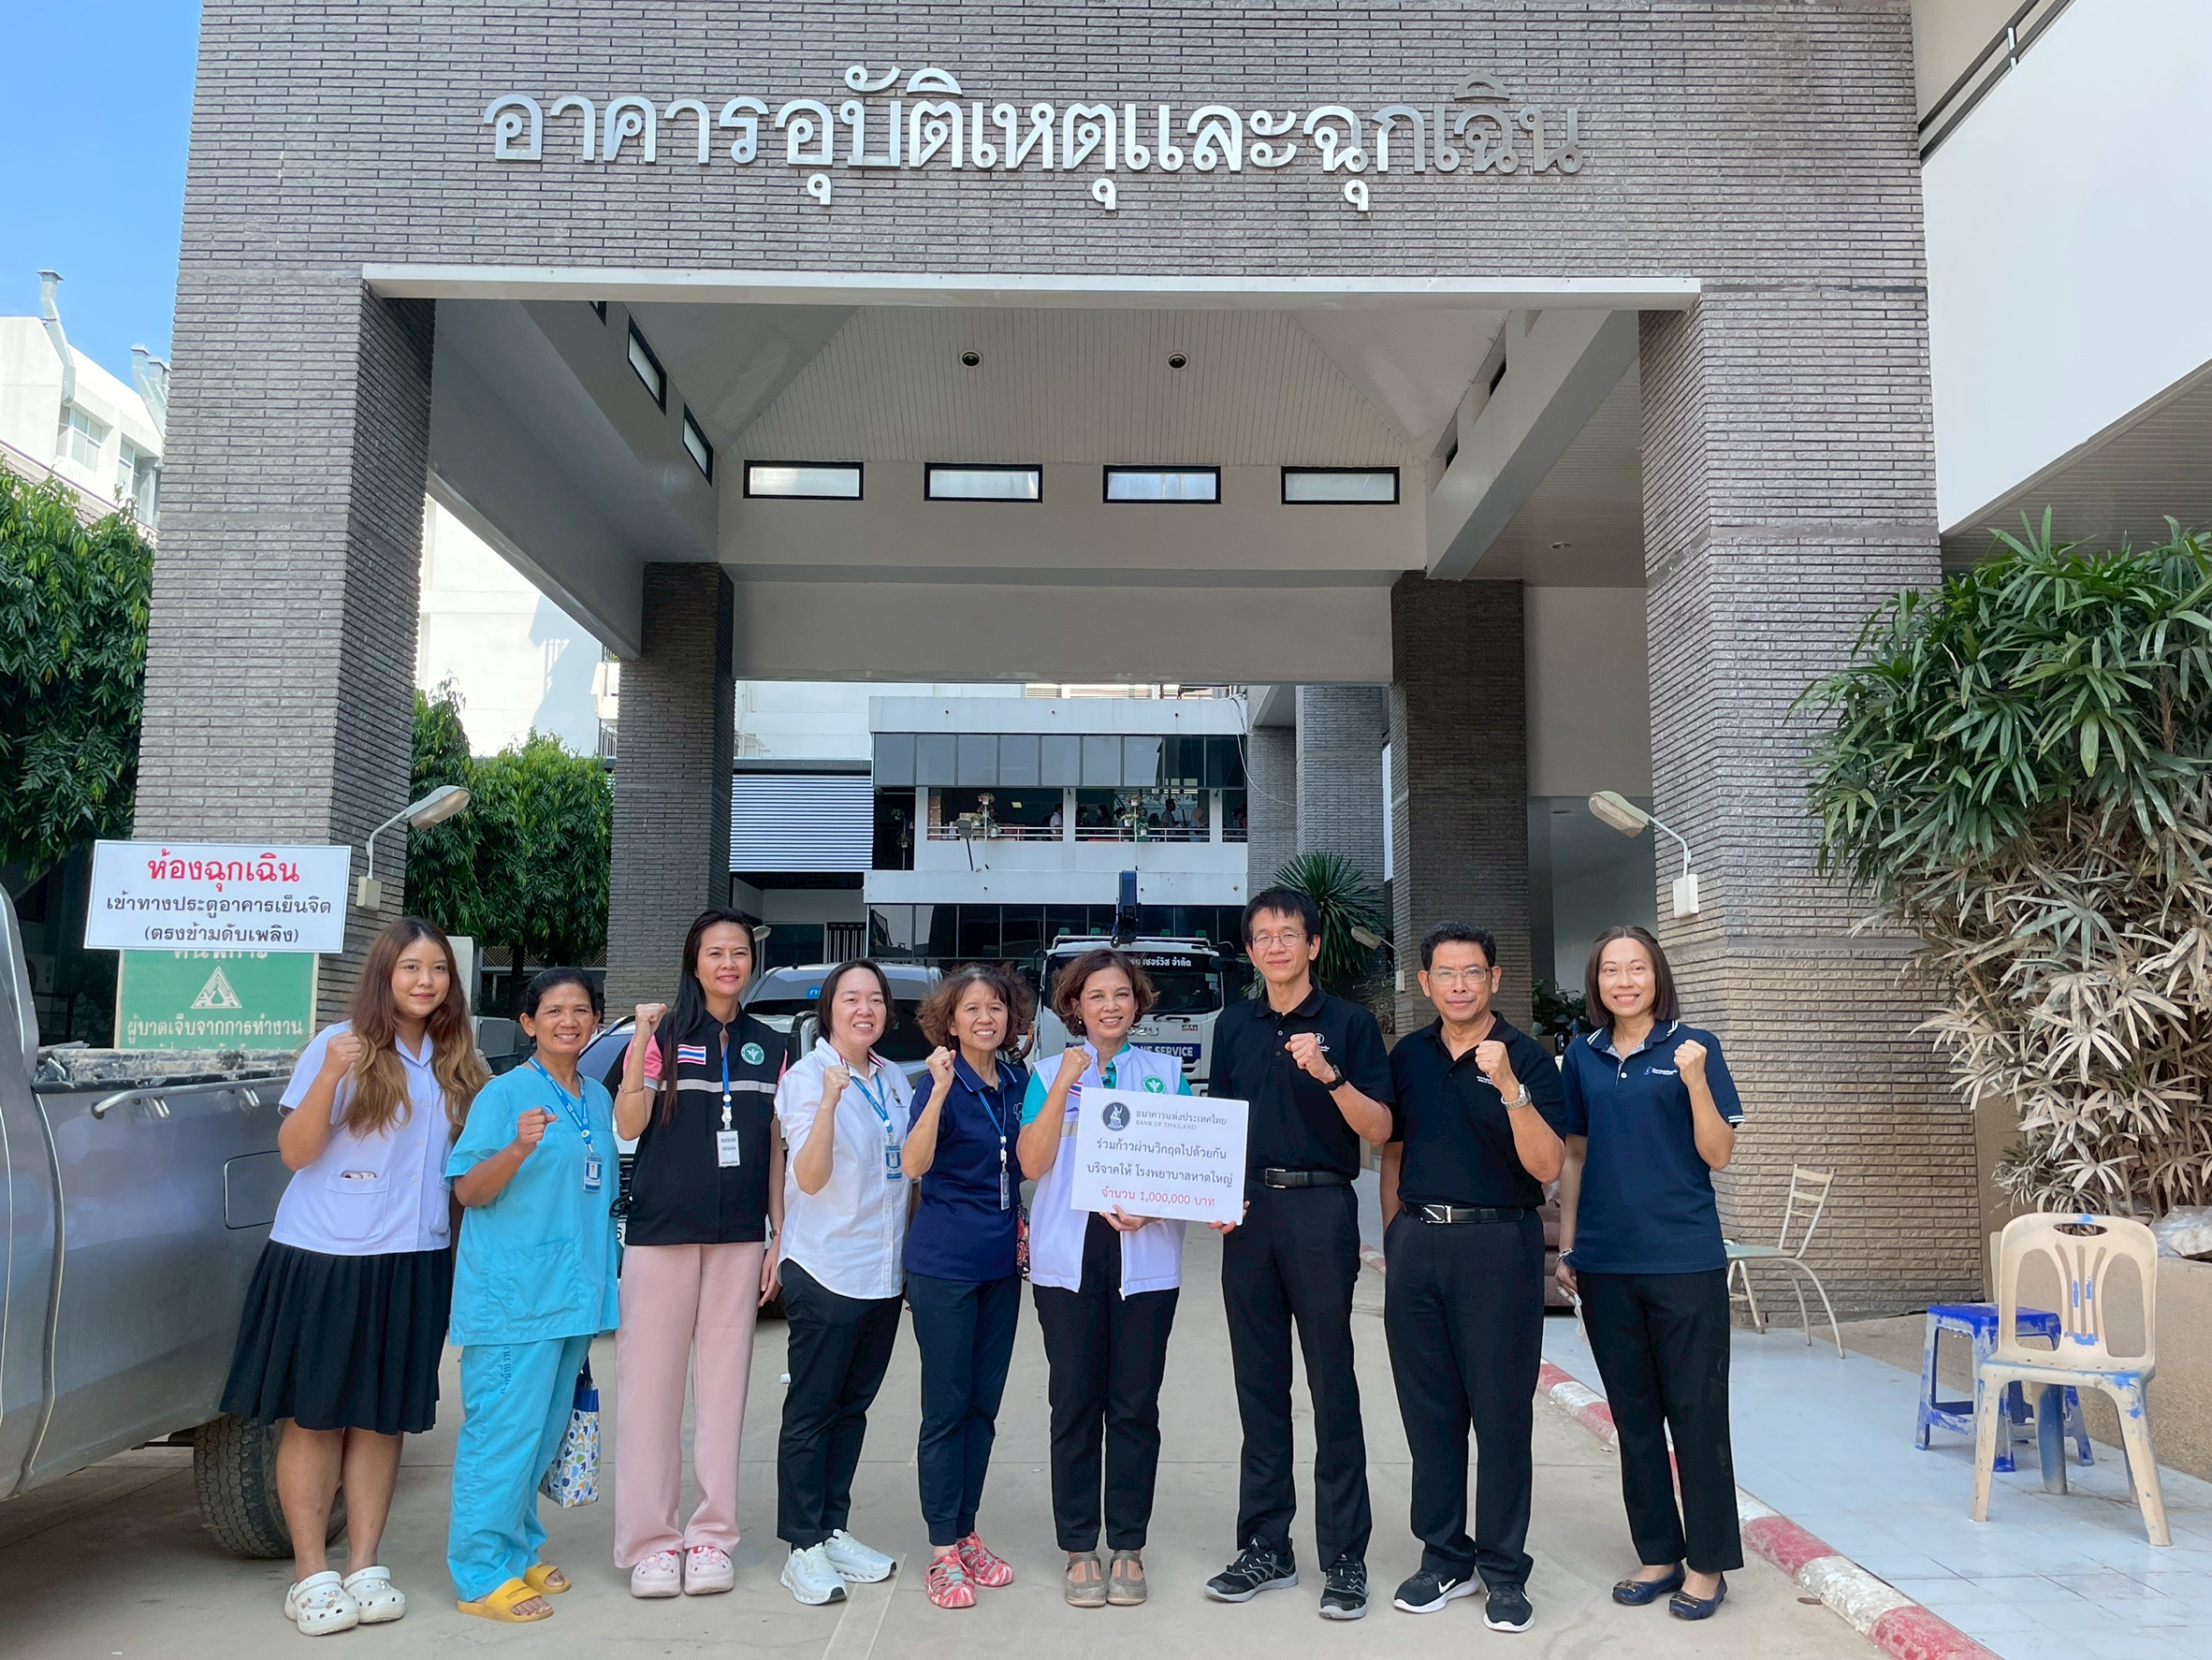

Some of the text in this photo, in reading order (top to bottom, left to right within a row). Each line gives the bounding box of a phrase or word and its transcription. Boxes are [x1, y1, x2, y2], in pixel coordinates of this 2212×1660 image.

[483, 64, 1584, 211] อาคารอุบัติเหตุและฉุกเฉิน
[148, 849, 300, 893] ห้องฉุกเฉิน
[107, 890, 331, 919] เข้าทางประตูอาคารเย็นจิต
[145, 922, 299, 943] (ตรงข้ามดับเพลิง)
[1171, 956, 1192, 967] จำกัด
[127, 1013, 303, 1044] ผู้บาดเจ็บจากการทำงาน
[1136, 1110, 1227, 1126] ธนาคารแห่งประเทศไทย
[1164, 1122, 1197, 1130] THAILAND
[1087, 1161, 1233, 1188] บริจาคให้ โรงพยาบาลหาดใหญ่
[1101, 1185, 1215, 1206] จำนวน 1,000,000 บาท
